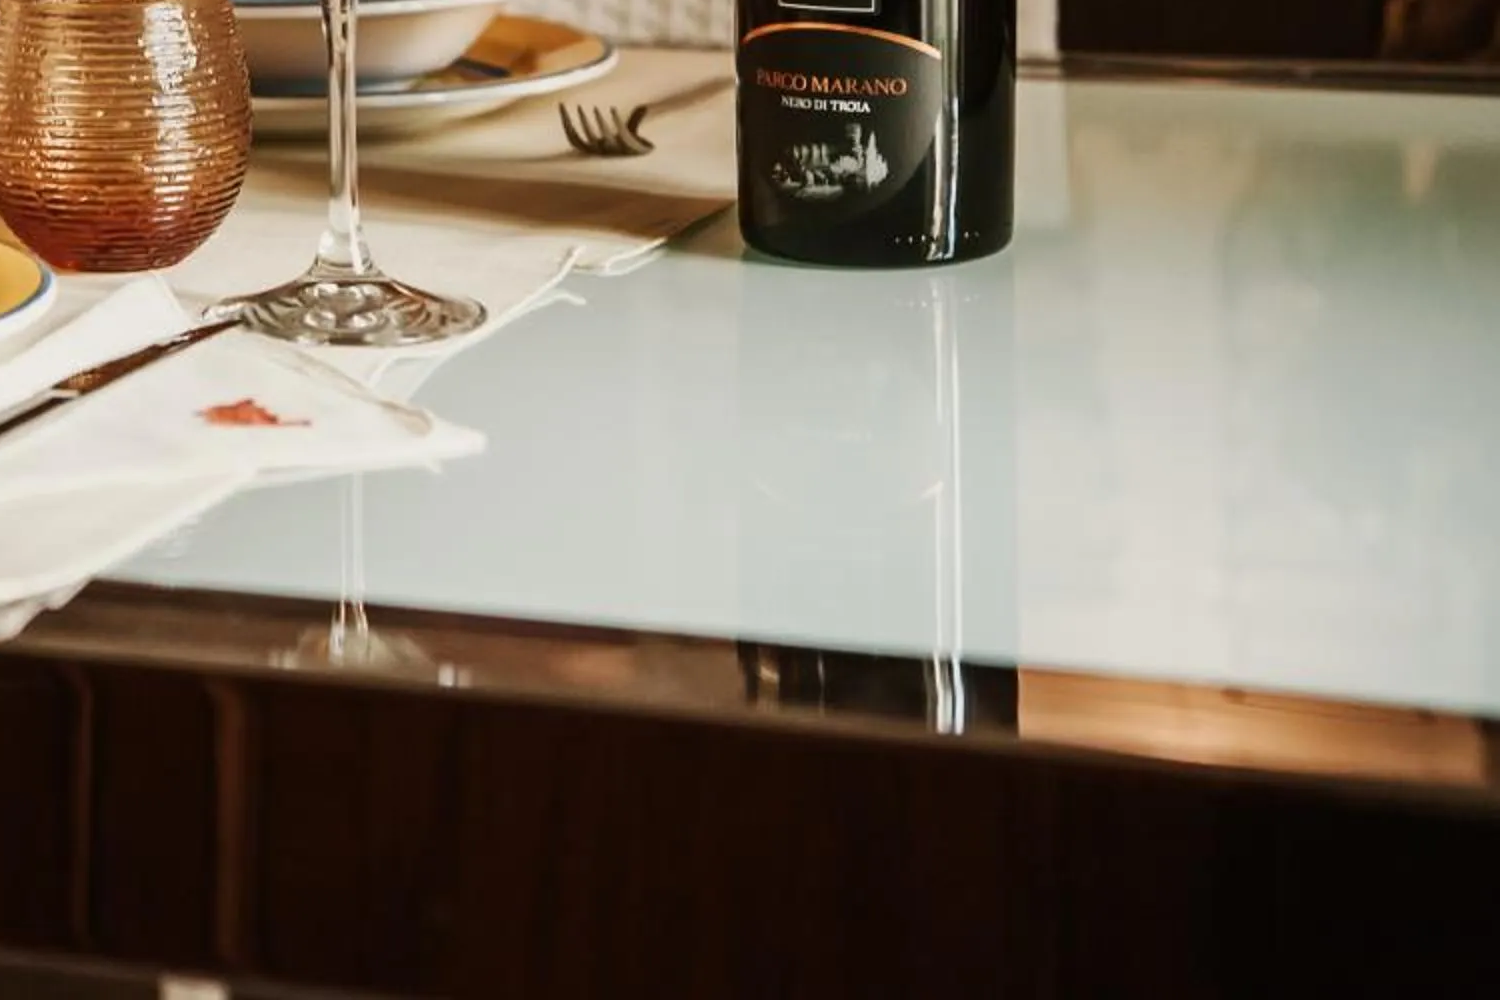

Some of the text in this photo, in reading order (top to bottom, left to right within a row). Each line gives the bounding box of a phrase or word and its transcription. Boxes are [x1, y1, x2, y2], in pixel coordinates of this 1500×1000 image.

[756, 68, 908, 96] PARCO MARANO
[781, 95, 871, 113] NERO DI TROIA
